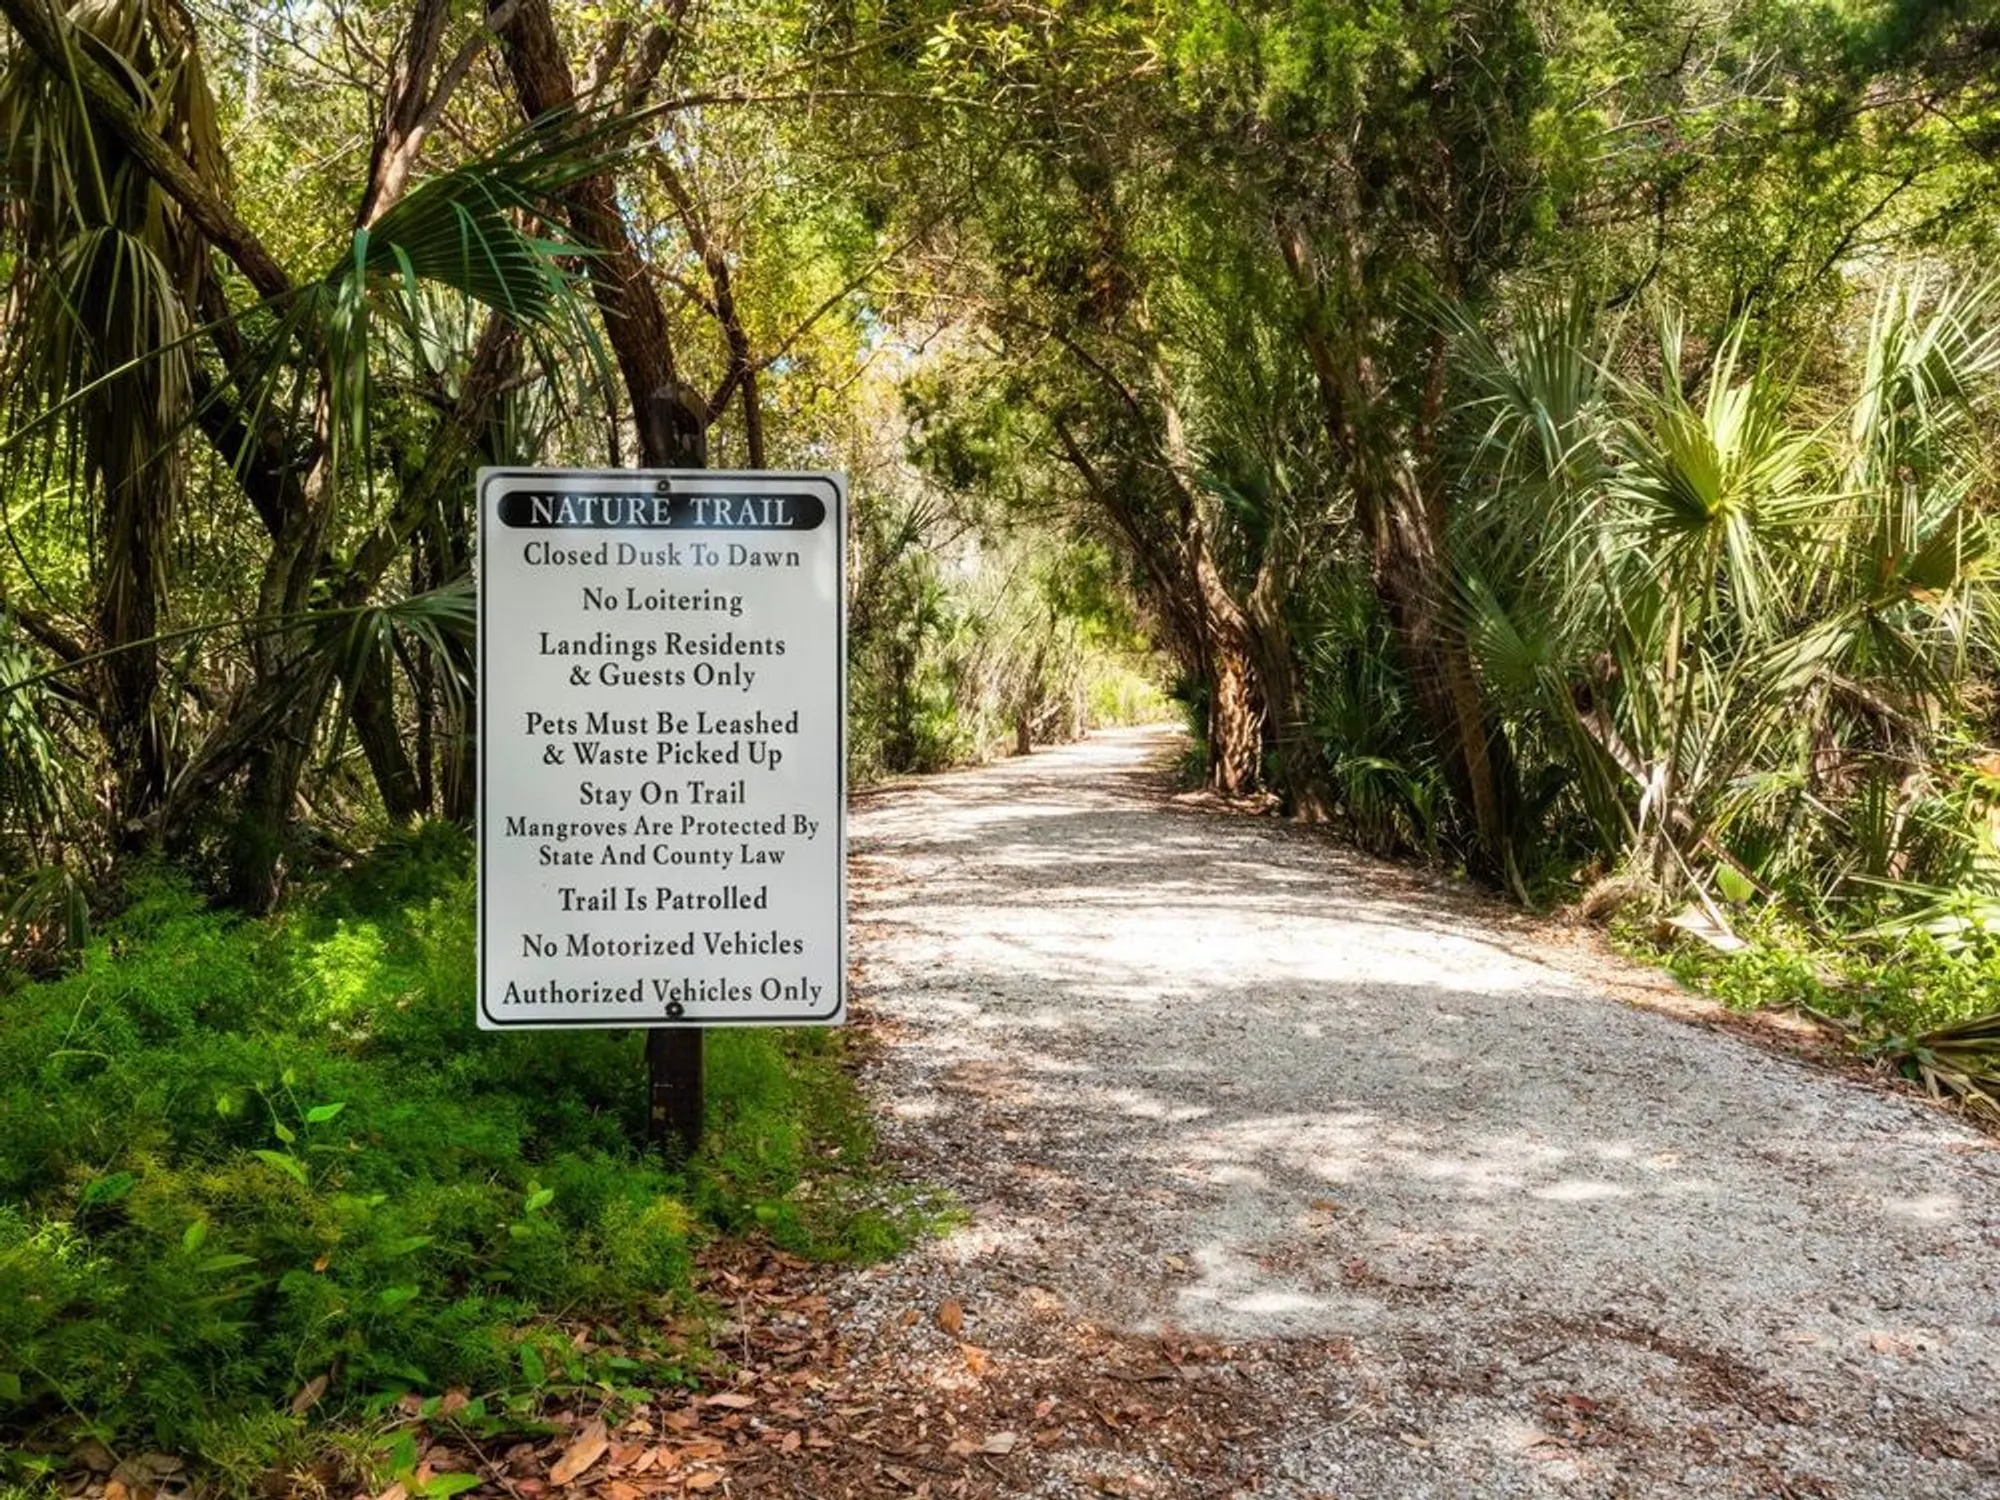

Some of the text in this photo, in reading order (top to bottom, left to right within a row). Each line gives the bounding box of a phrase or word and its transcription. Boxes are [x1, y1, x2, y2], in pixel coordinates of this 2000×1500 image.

[532, 497, 793, 525] NATURE TRAIL
[524, 540, 799, 566] Closed Dusk To Dawn
[583, 587, 743, 617] No Loitering
[539, 632, 785, 660] Landings Residents
[569, 662, 755, 692] & Guests Only
[525, 710, 798, 735] Pets Must Be Leashed
[543, 740, 782, 771] & Waste Picked Up
[580, 780, 745, 811] Stay On Trail
[506, 814, 819, 842] Mangroves Are Protected By
[539, 844, 785, 870] State And County Law
[558, 885, 767, 911] Trail Is Patrolled
[522, 930, 803, 957] No Motorized Vehicles
[503, 976, 822, 1007] Authorized Vehicles Only
